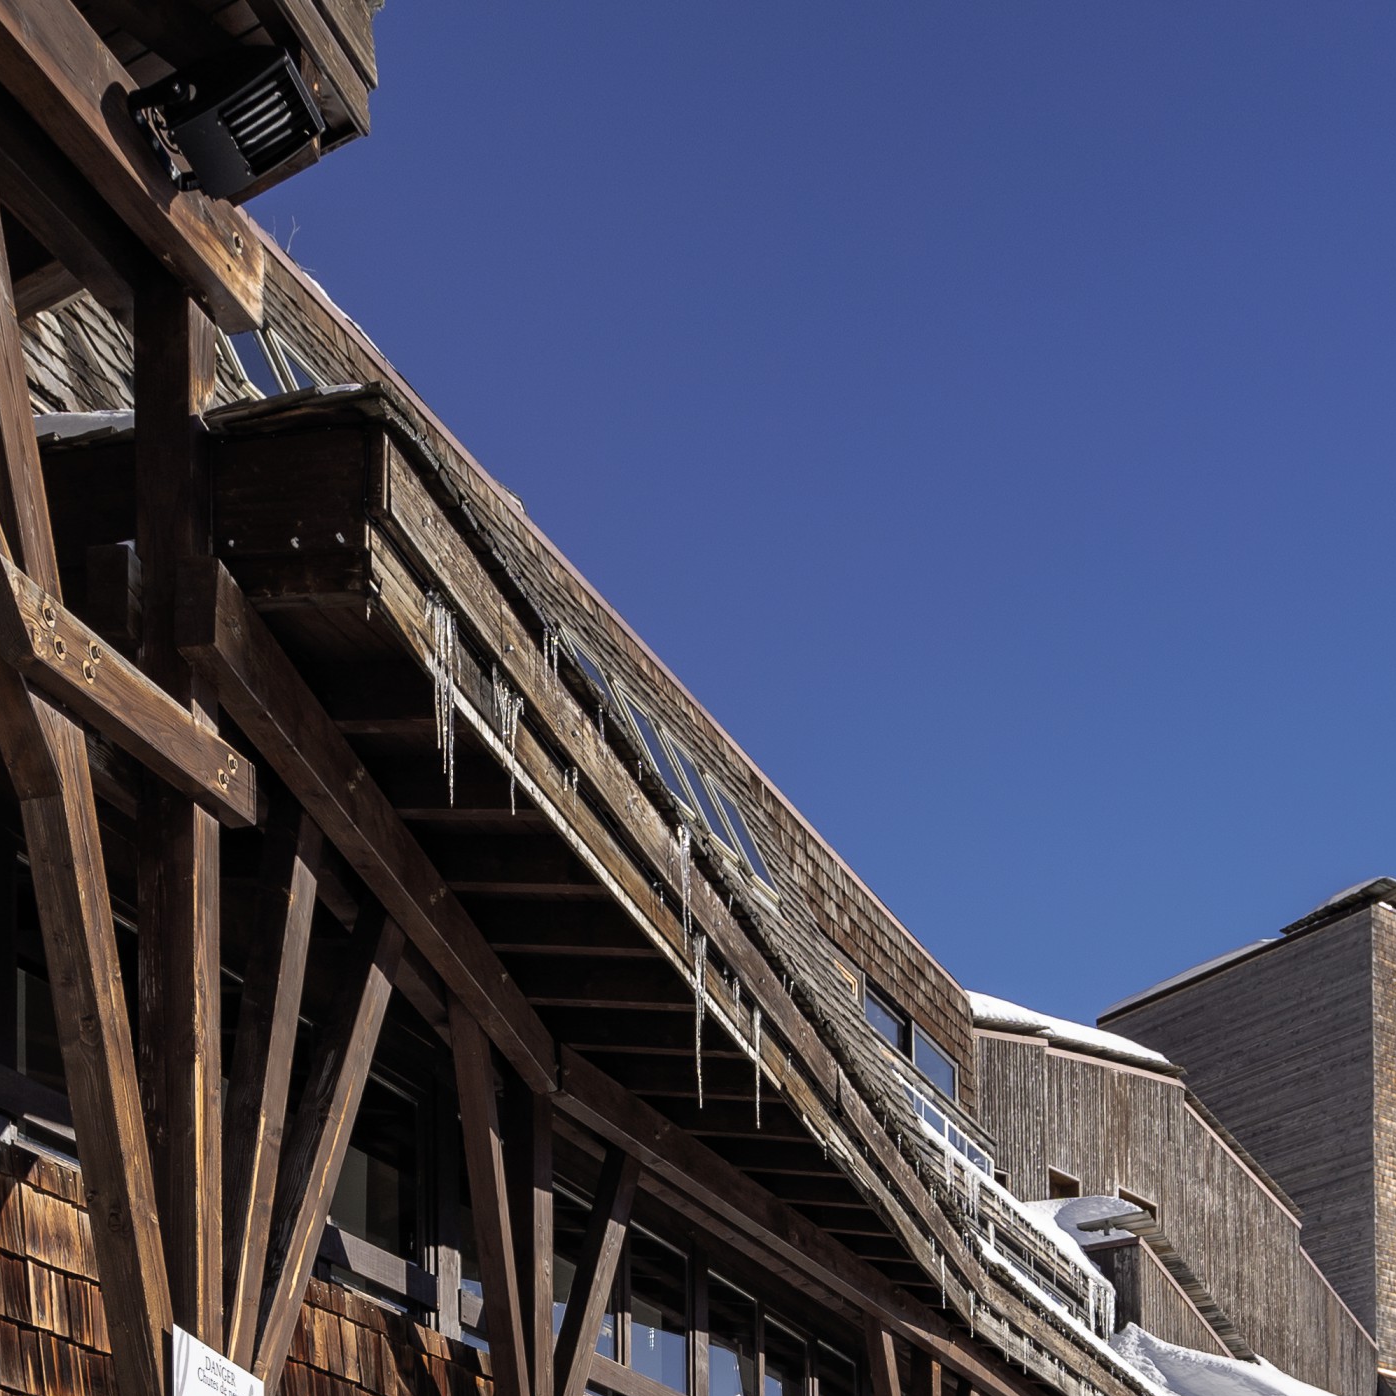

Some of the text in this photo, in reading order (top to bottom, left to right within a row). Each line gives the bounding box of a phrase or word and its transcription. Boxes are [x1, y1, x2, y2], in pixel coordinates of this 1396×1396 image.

[197, 1366, 219, 1391] Chutes
[219, 1380, 227, 1396] de
[205, 1355, 236, 1388] DANGER
